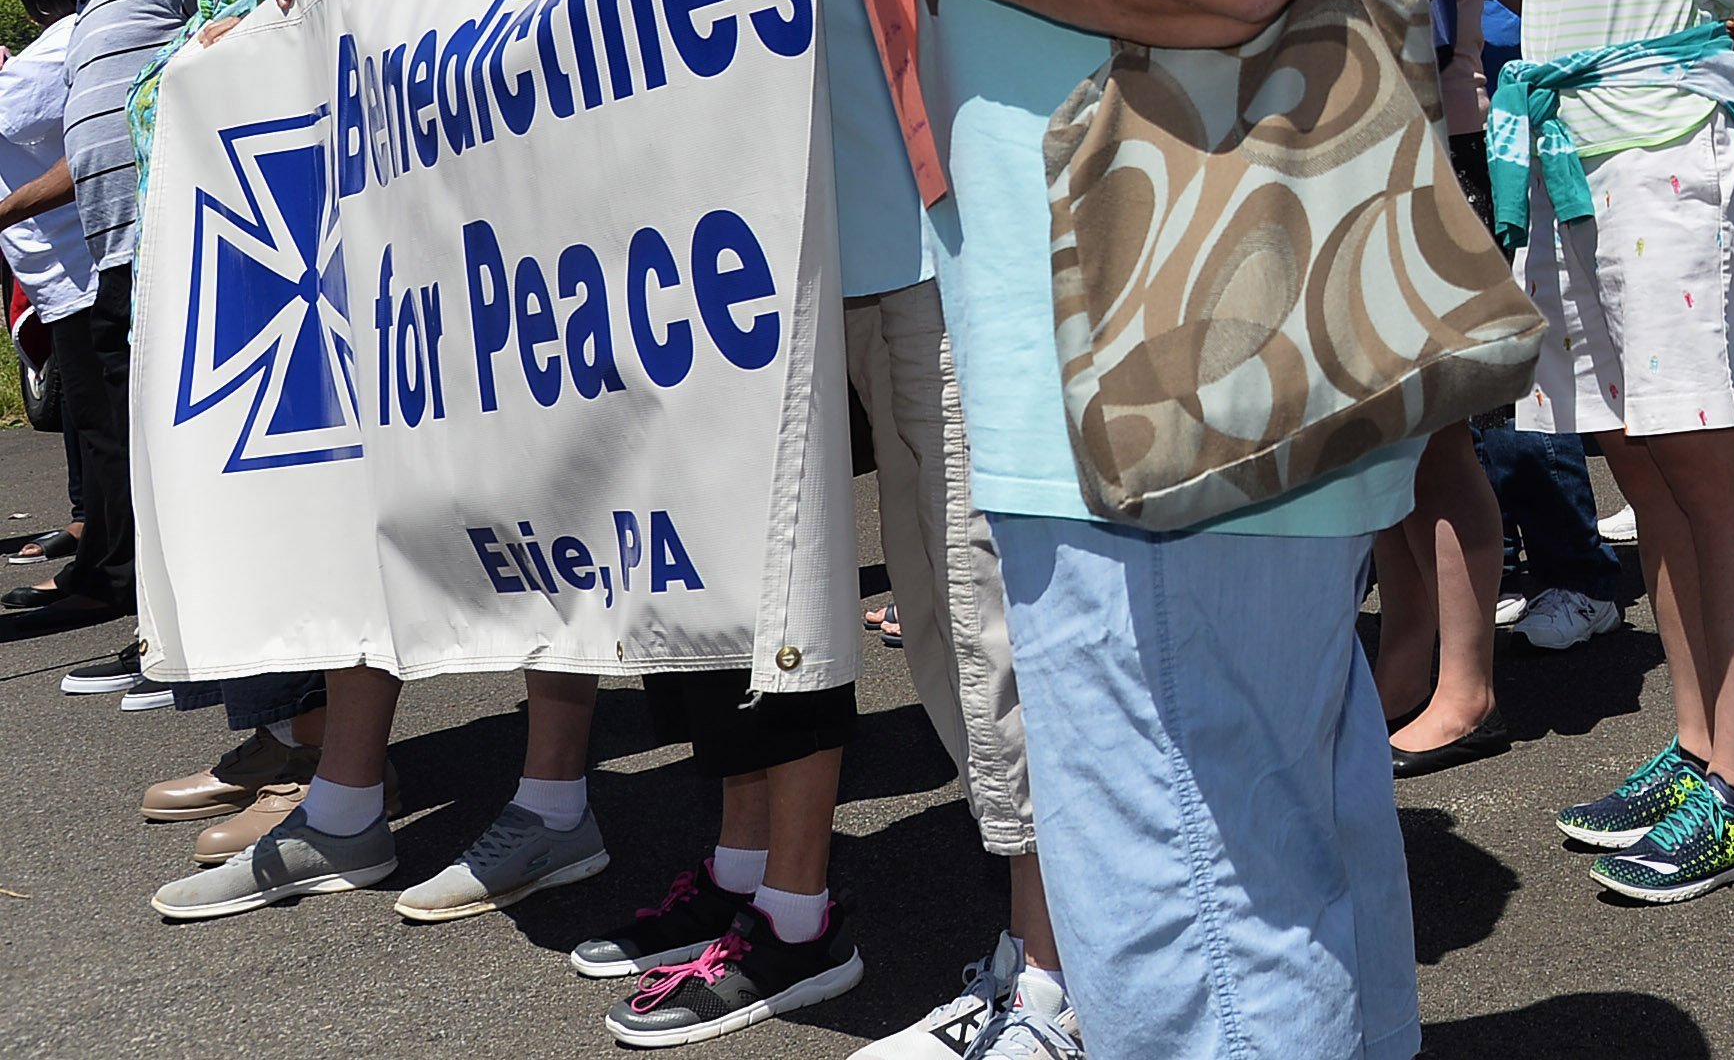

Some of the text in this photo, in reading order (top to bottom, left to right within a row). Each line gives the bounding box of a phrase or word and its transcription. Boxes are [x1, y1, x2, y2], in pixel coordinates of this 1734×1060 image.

[374, 209, 781, 429] for Peace
[465, 508, 706, 610] Erie, PA
